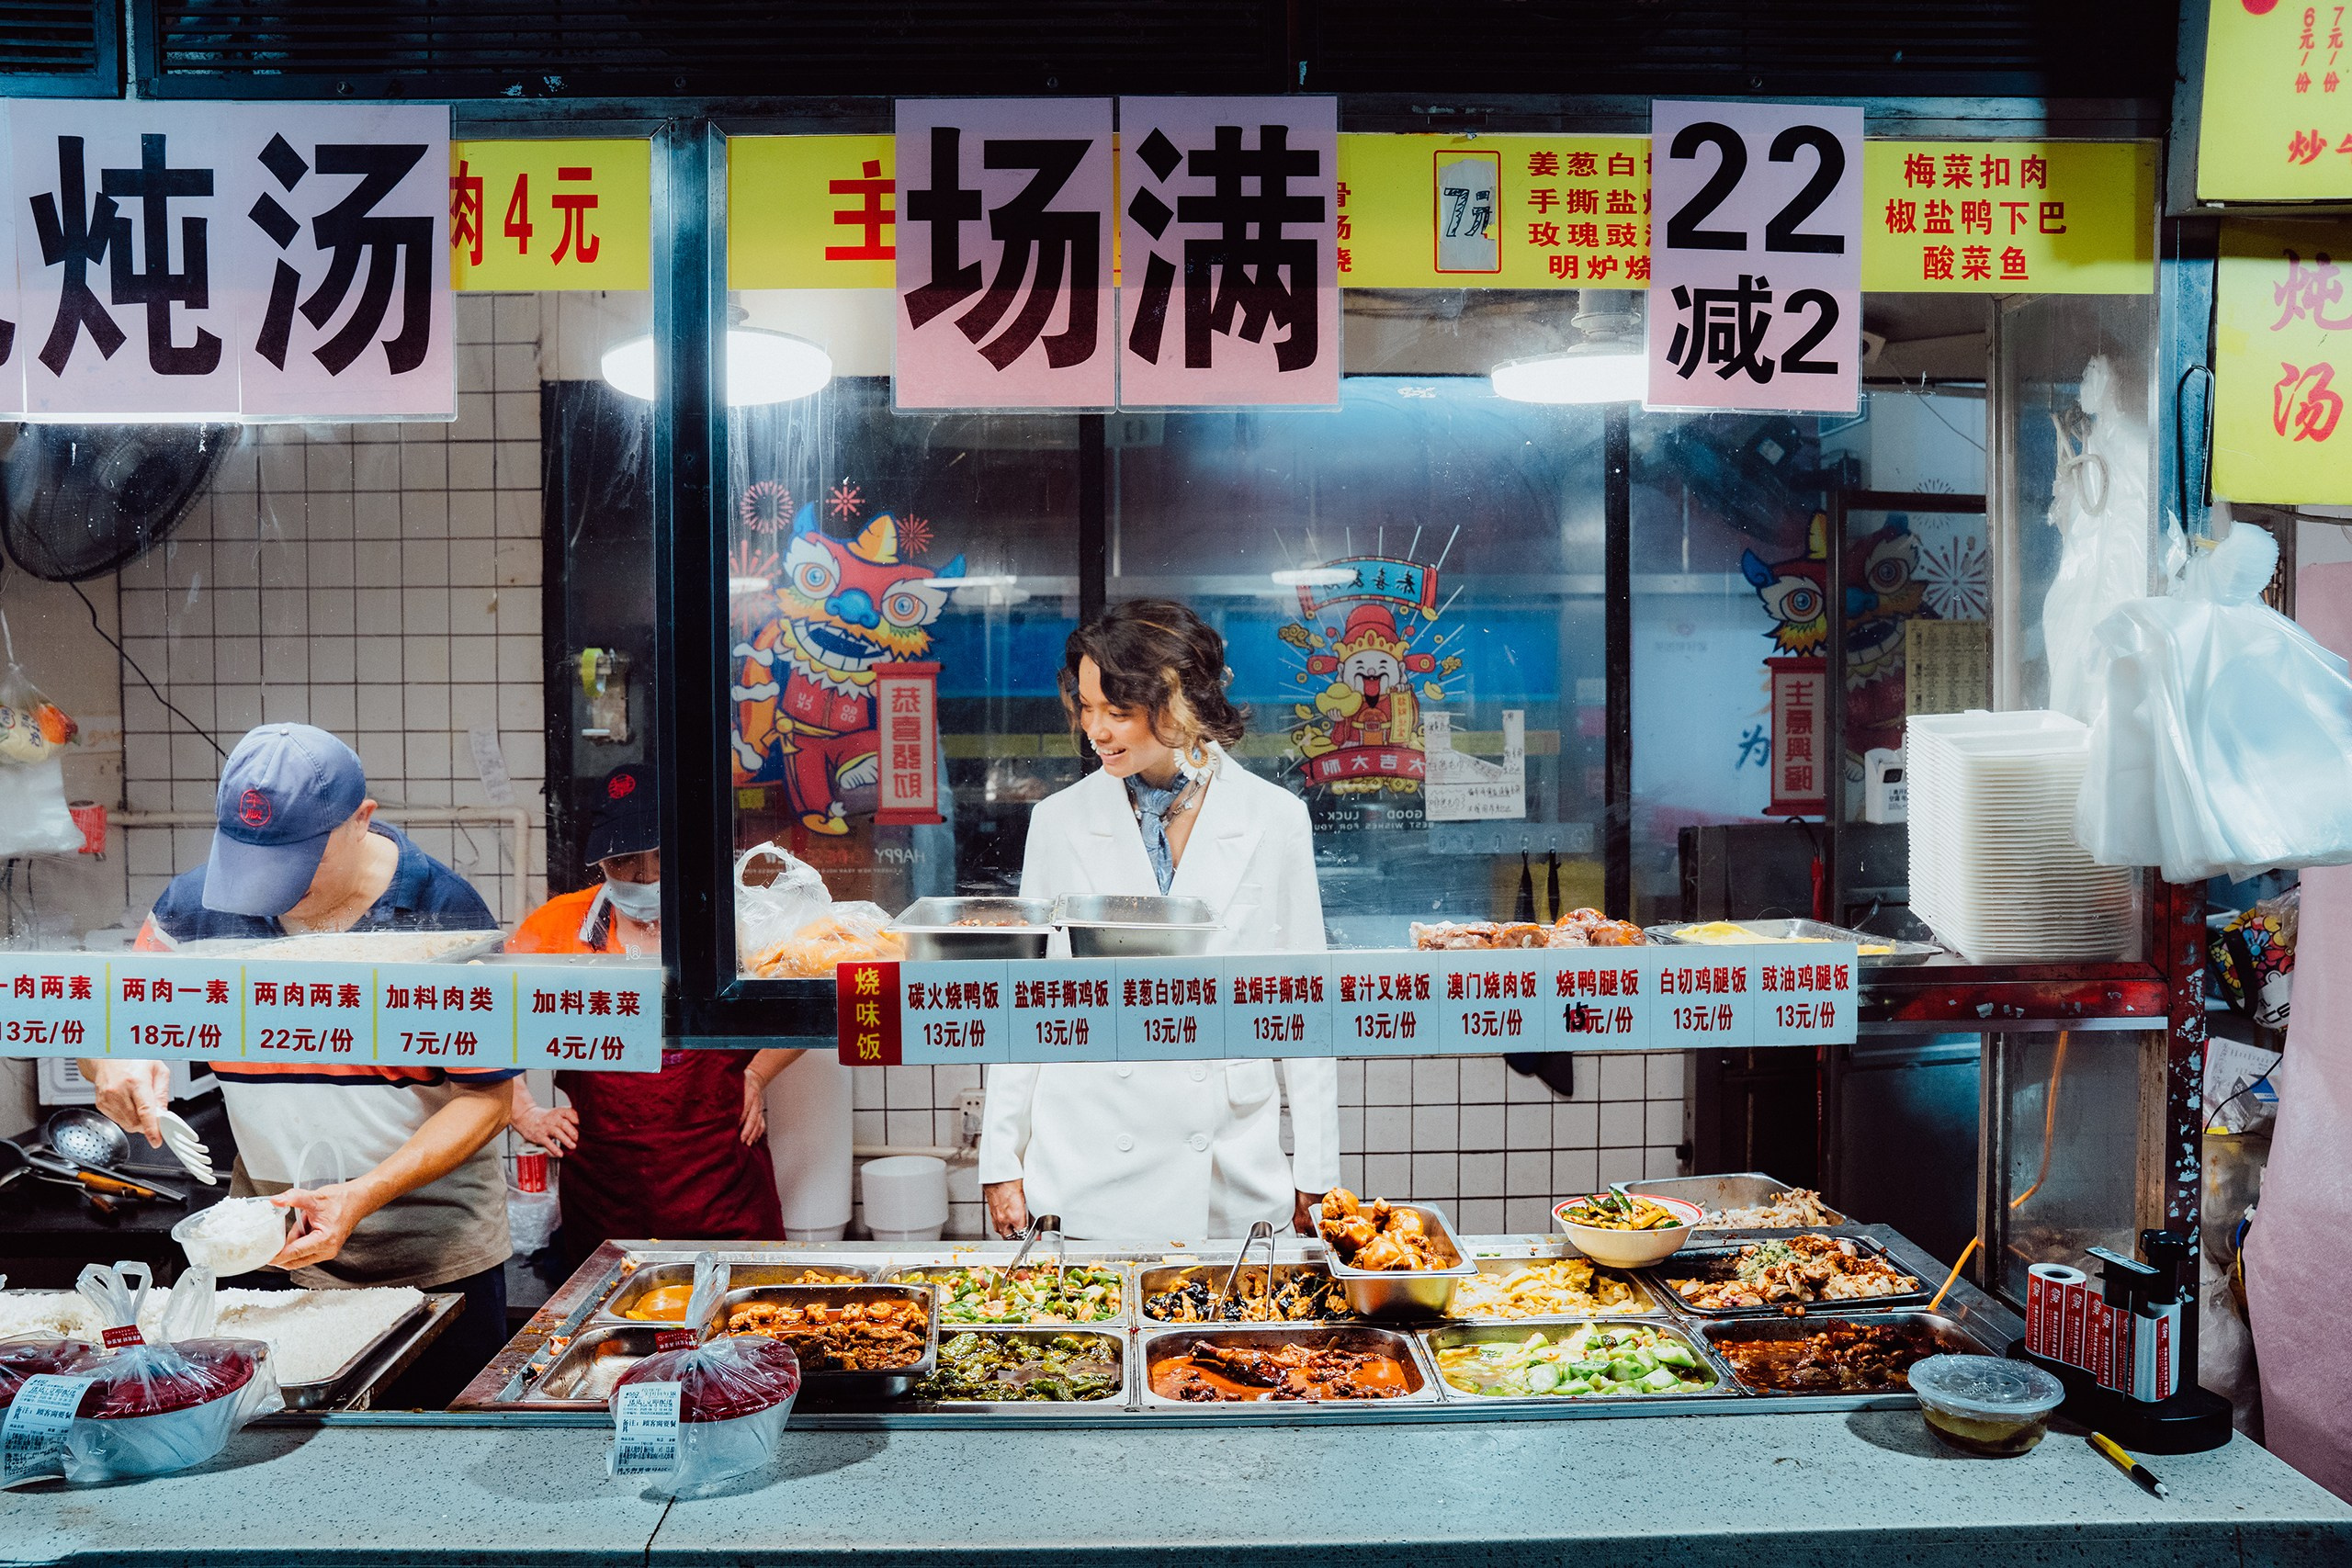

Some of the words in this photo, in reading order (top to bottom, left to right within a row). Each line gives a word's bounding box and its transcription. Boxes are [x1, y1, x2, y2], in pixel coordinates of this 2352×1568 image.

[2295, 6, 2315, 93] 6元/份
[2324, 6, 2345, 93] 7元/份
[1904, 153, 2049, 189] 梅菜扣肉
[1668, 121, 1846, 254] 22
[1885, 199, 2067, 235] 椒盐鸭下巴
[0, 133, 434, 378] 炖汤
[904, 125, 1325, 372] 场满
[1923, 245, 2030, 282] 酸菜鱼
[1667, 276, 1839, 384] 减2
[122, 977, 230, 1004] 两肉一素
[1123, 977, 1217, 1008] 姜葱白切鸡饭
[1234, 975, 1324, 1005] 盐焗手撕鸡饭
[1340, 973, 1430, 1003] 蜜汁叉烧饭
[1447, 971, 1537, 1000] 澳门烧肉饭
[1556, 968, 1640, 998] 烧鸭腿饭
[1660, 965, 1747, 995] 白切鸡腿饭
[1761, 964, 1849, 993] 豉油鸡腿饭
[254, 982, 361, 1009] 两肉两素
[386, 984, 493, 1011] 加料肉类
[532, 988, 641, 1017] 加料素菜
[908, 981, 1000, 1010] 碳火烧鸭饭
[1014, 979, 1110, 1010] 盐焗手撕鸡饭
[854, 967, 881, 1060] 烧味饭
[1253, 1013, 1305, 1042] 13元/份
[1355, 1010, 1417, 1039] 13元/份
[1462, 1009, 1523, 1037] 13元/份
[1674, 1003, 1734, 1032] 13元/份
[1776, 1001, 1836, 1030] 13元/份
[130, 1023, 222, 1049] 18元/份
[260, 1028, 354, 1053] 22元/份
[400, 1031, 479, 1056] 7元/份
[923, 1019, 986, 1047] 13元/份
[1035, 1017, 1090, 1046] 13元/份
[1143, 1015, 1197, 1043] 13元/份
[546, 1035, 626, 1061] 4元/份
